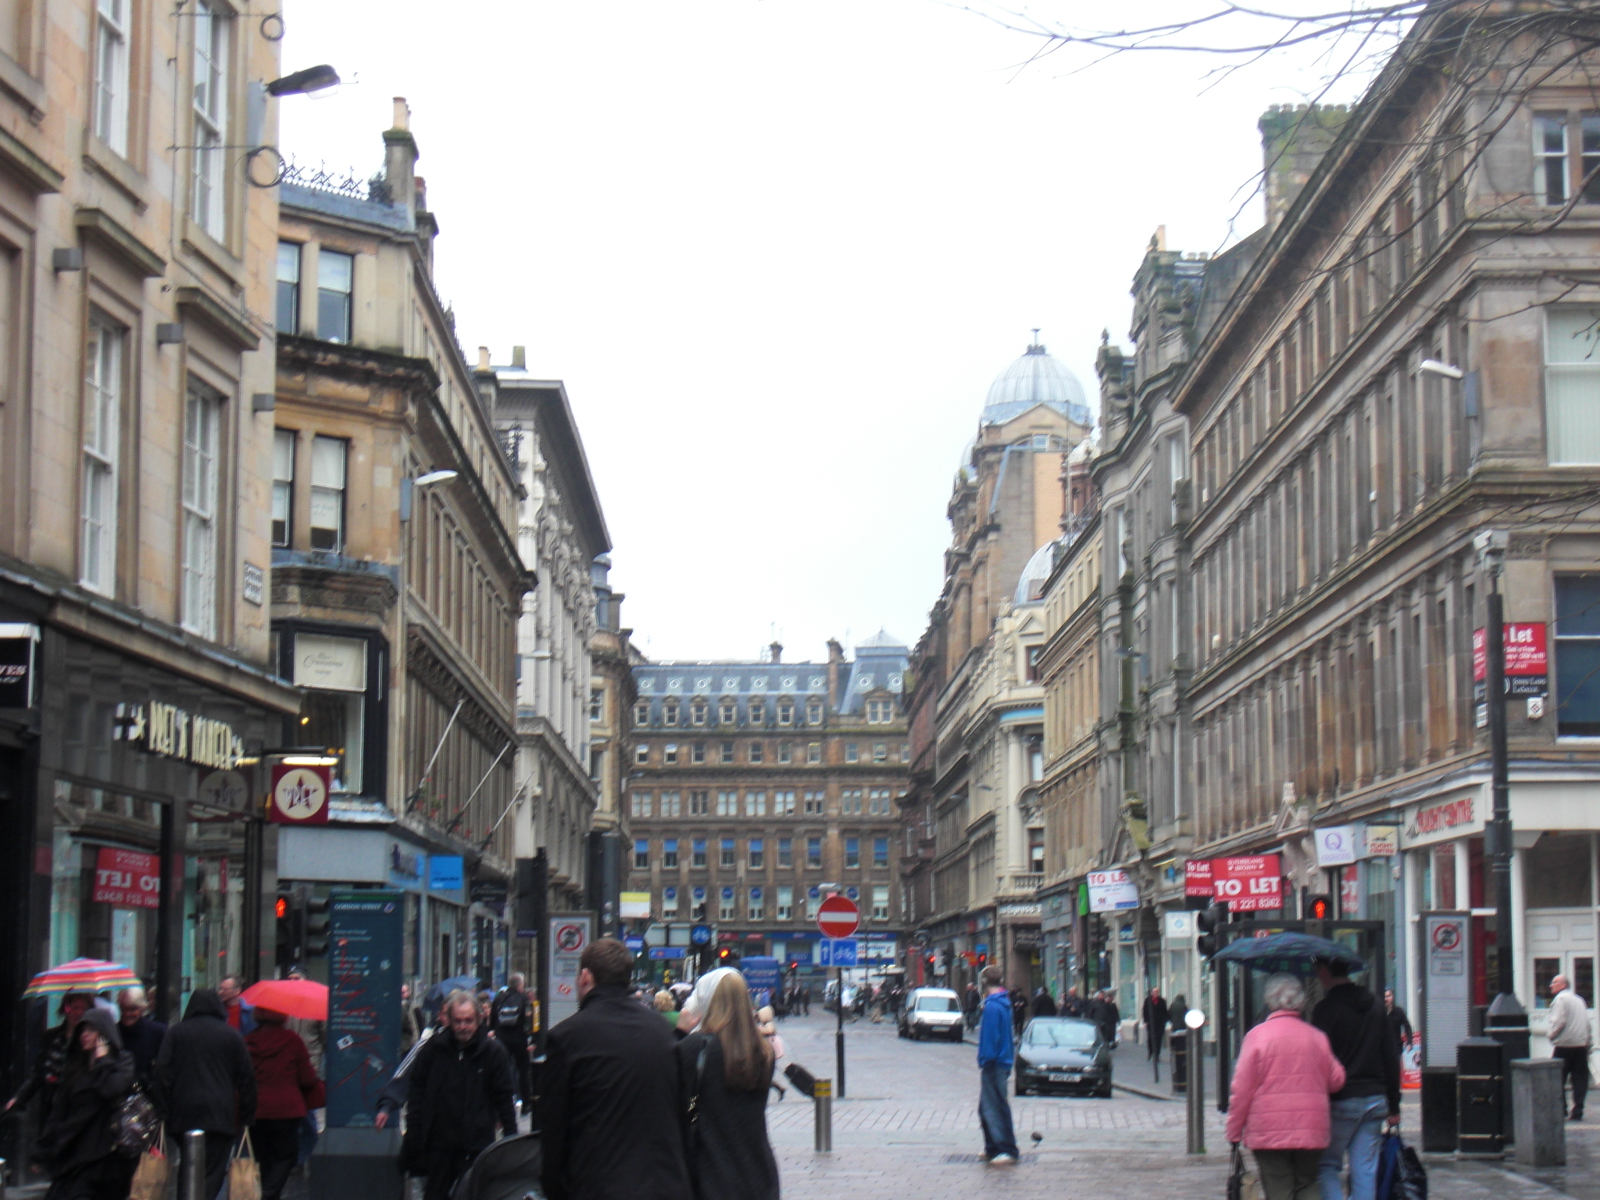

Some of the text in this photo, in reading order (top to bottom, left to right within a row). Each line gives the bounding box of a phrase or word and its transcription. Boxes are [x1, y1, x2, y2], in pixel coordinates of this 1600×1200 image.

[1510, 626, 1534, 643] Let
[1089, 872, 1127, 884] TO LE
[1214, 879, 1242, 896] TO
[1249, 877, 1280, 894] LET
